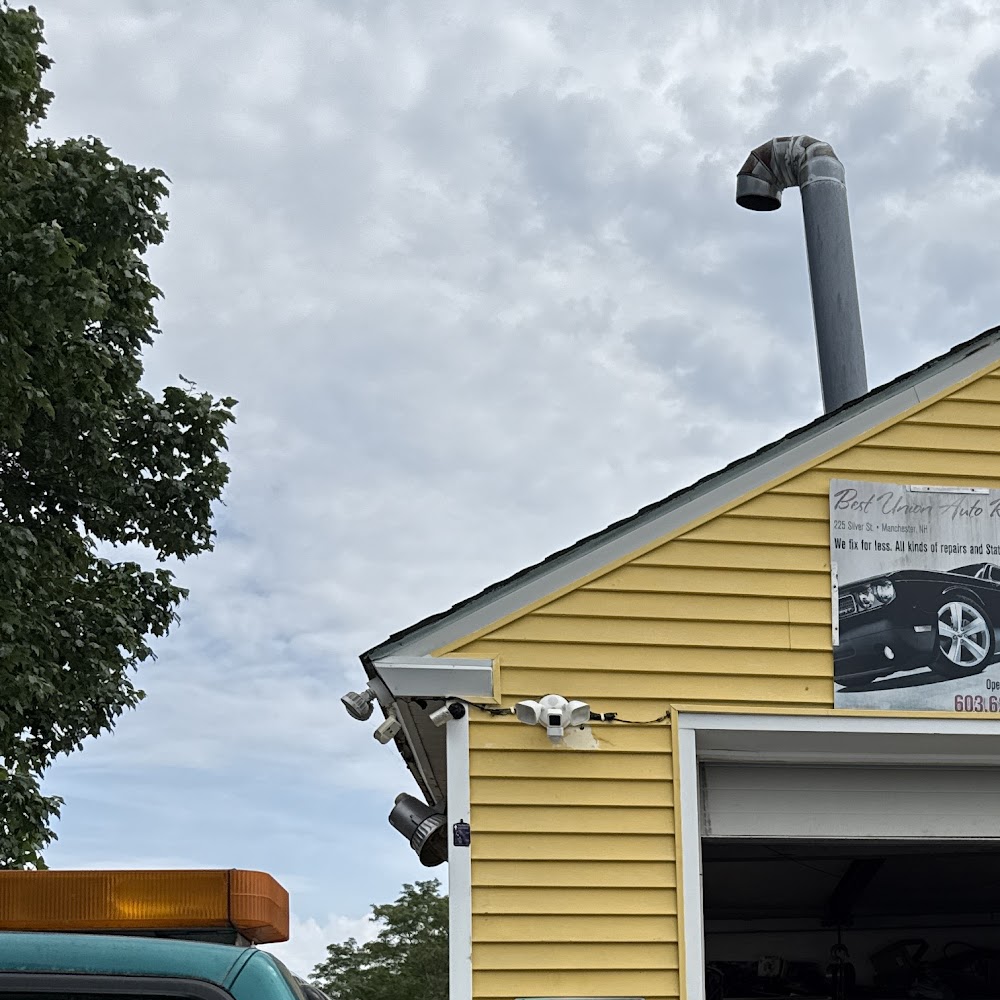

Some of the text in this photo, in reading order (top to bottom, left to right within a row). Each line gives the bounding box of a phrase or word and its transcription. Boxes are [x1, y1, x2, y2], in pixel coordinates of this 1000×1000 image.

[834, 488, 876, 514] Best
[876, 492, 932, 515] Union
[939, 496, 983, 521] Auto
[834, 520, 846, 530] 225
[847, 521, 864, 531] Silver
[919, 525, 928, 533] NH
[834, 537, 846, 550] We
[849, 539, 858, 550] fix
[861, 539, 872, 551] for
[874, 540, 892, 551] less.
[895, 540, 905, 552] All
[907, 540, 928, 553] kinds
[930, 541, 938, 553] of
[940, 543, 967, 555] repairs
[970, 544, 983, 555] and
